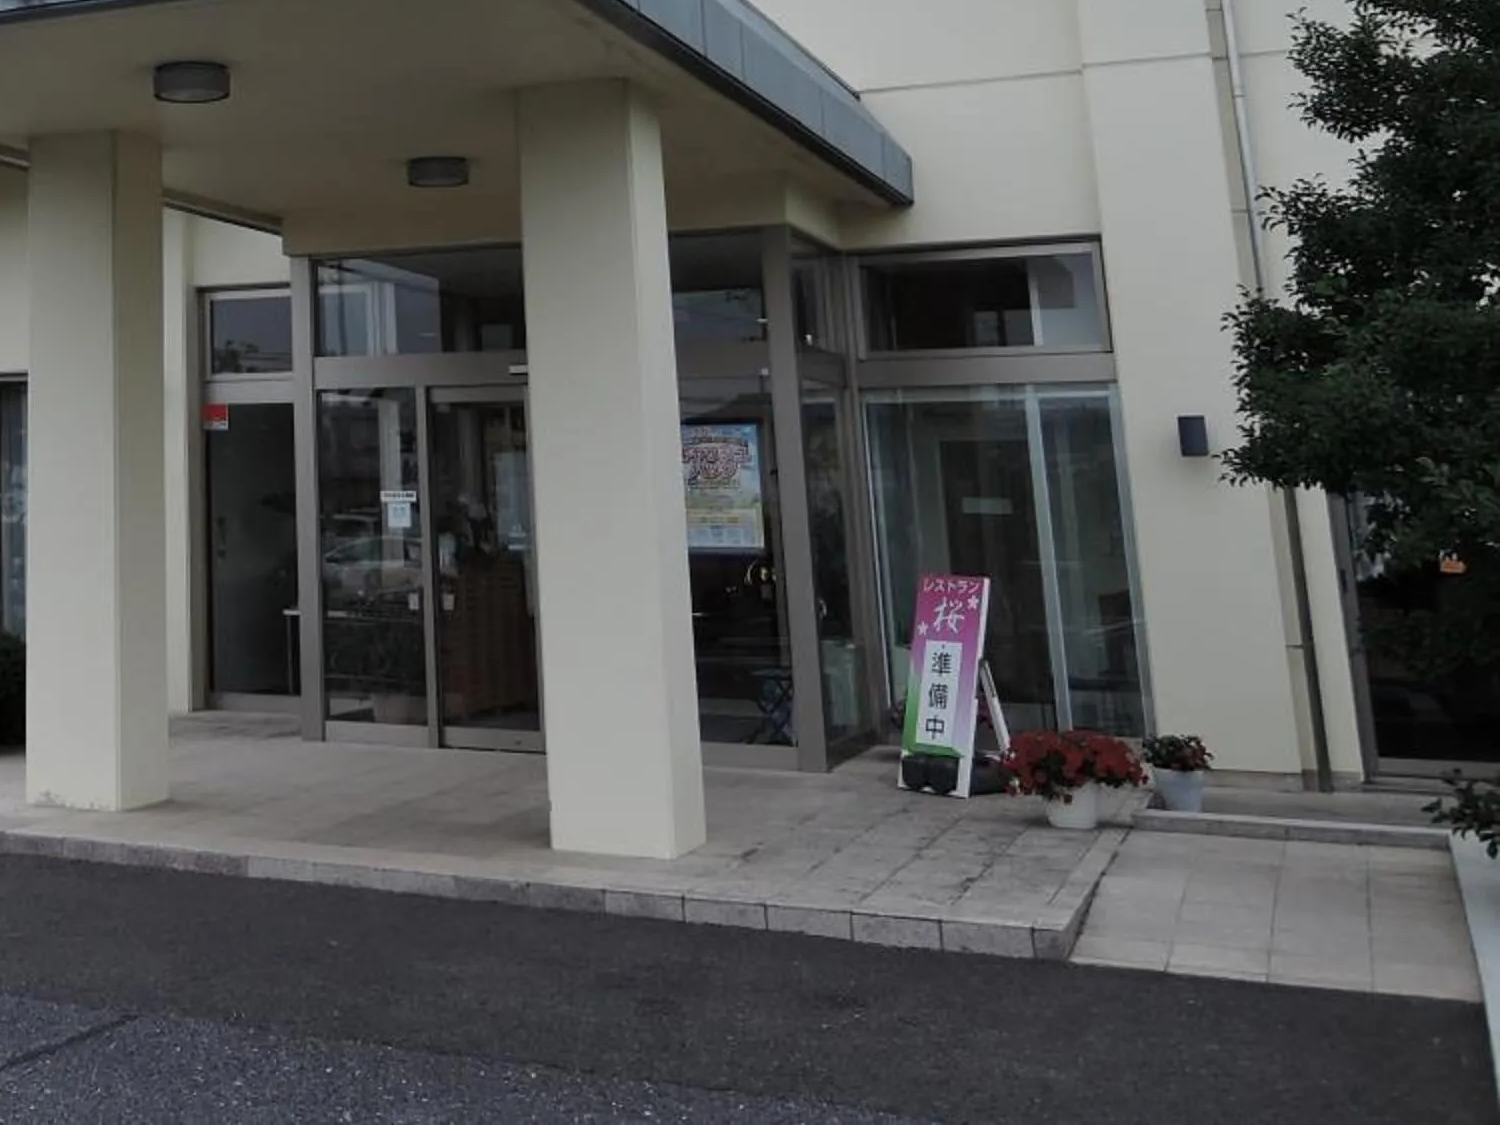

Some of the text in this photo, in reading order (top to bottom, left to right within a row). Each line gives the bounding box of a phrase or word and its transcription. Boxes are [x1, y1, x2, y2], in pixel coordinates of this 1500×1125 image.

[923, 578, 980, 593] レストラン
[933, 596, 965, 634] 桜
[925, 651, 952, 739] 準備中
